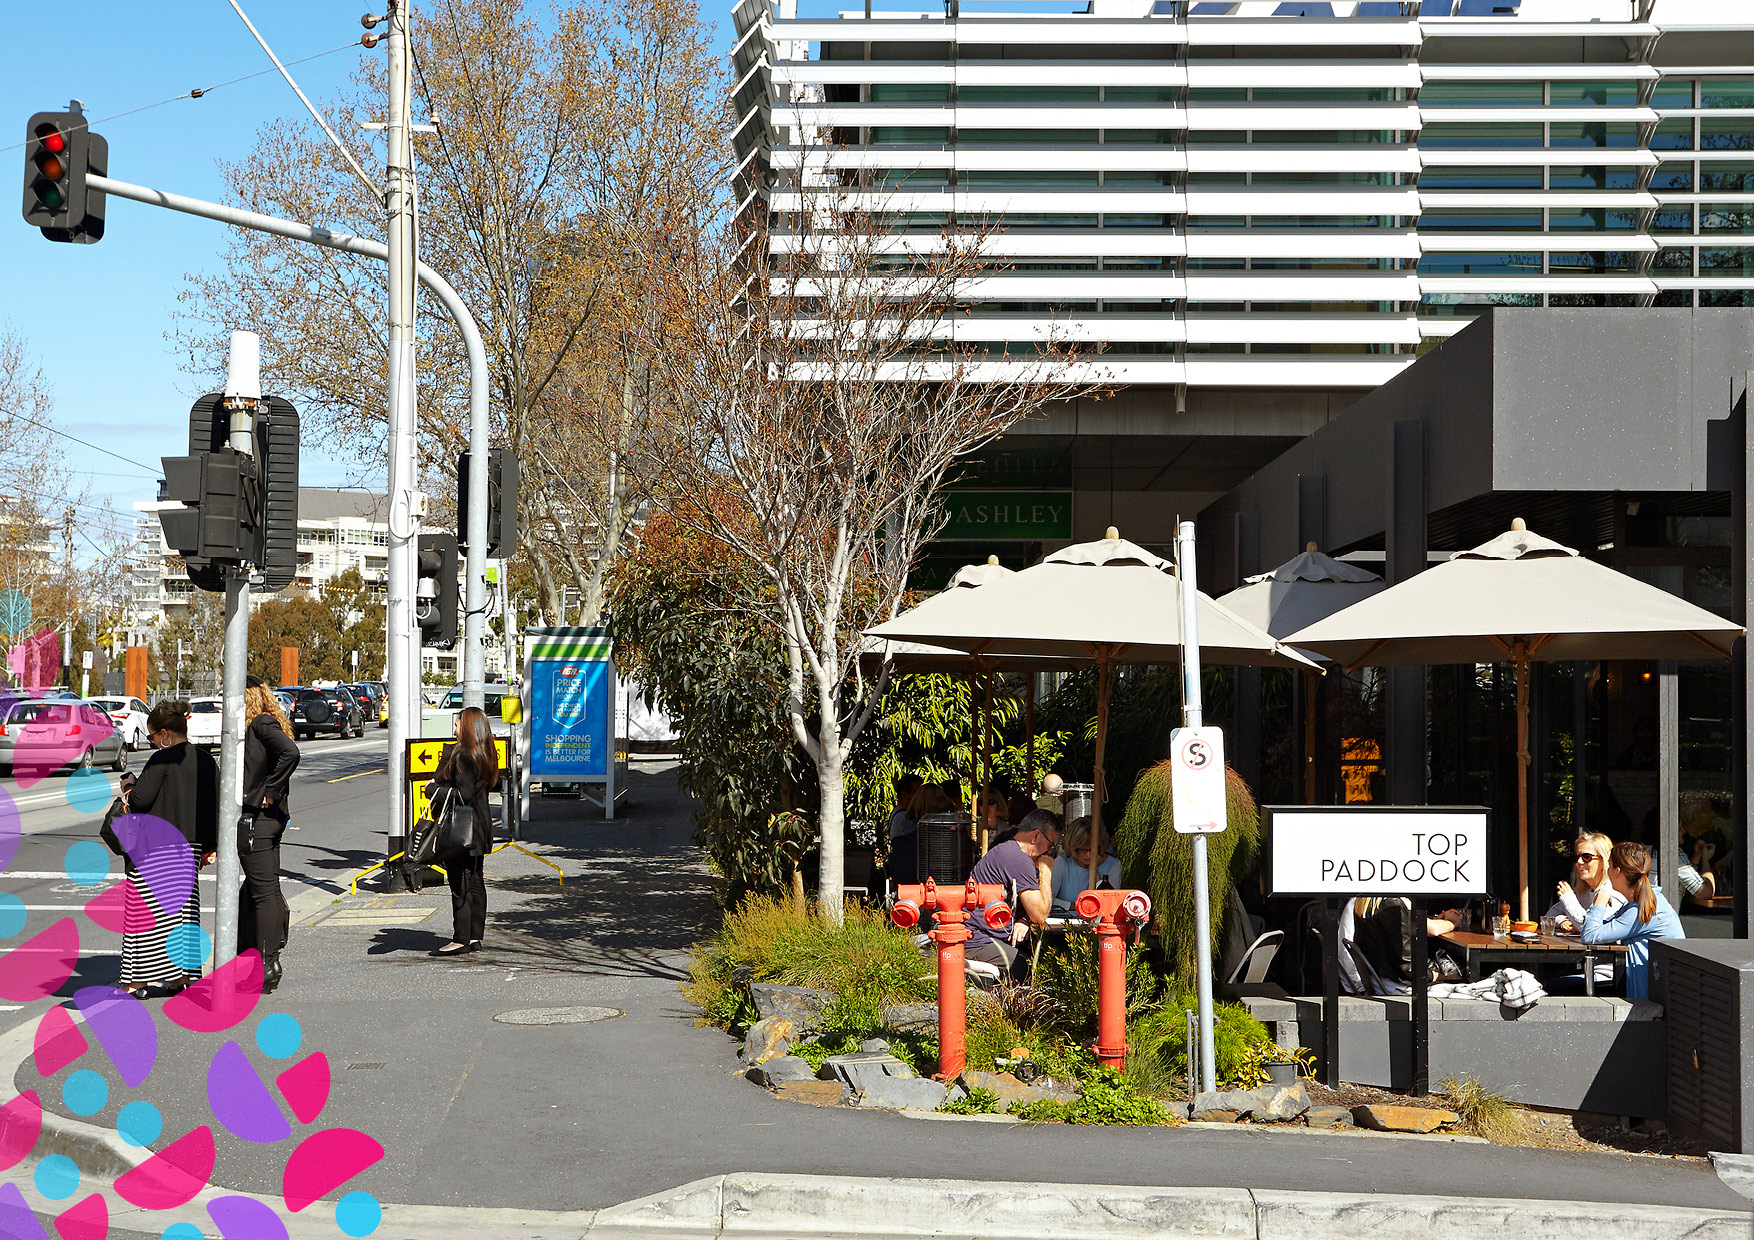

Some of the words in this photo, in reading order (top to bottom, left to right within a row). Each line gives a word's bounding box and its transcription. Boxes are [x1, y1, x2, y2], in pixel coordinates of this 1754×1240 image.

[956, 505, 1064, 523] ASHLEY
[562, 667, 578, 676] IGA
[556, 678, 581, 687] PRICE
[545, 734, 592, 743] SHOPPING
[1411, 833, 1468, 856] TOP
[1321, 859, 1470, 882] PADDOCK
